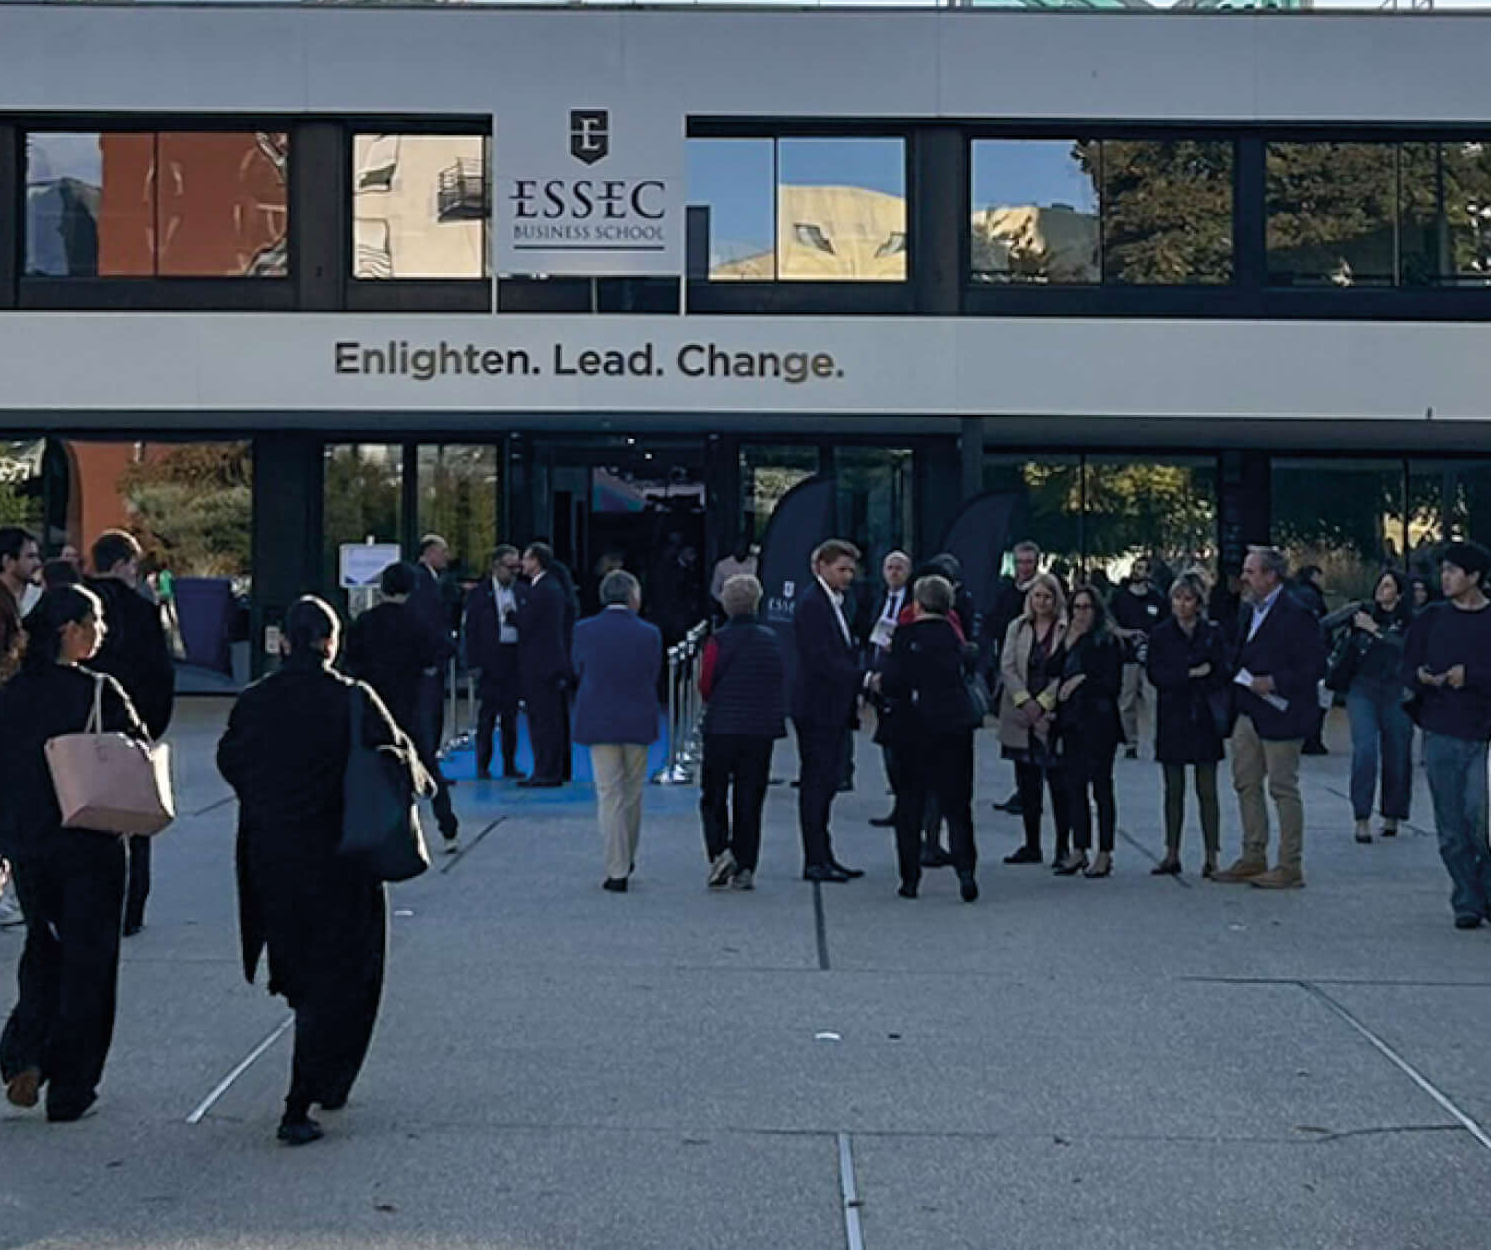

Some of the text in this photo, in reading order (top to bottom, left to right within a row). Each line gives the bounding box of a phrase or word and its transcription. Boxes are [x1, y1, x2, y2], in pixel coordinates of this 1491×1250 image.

[510, 180, 666, 219] ESSEC
[513, 225, 665, 240] BUSINESS SCHOOL
[334, 340, 844, 384] Enlighten. Lead. Change.
